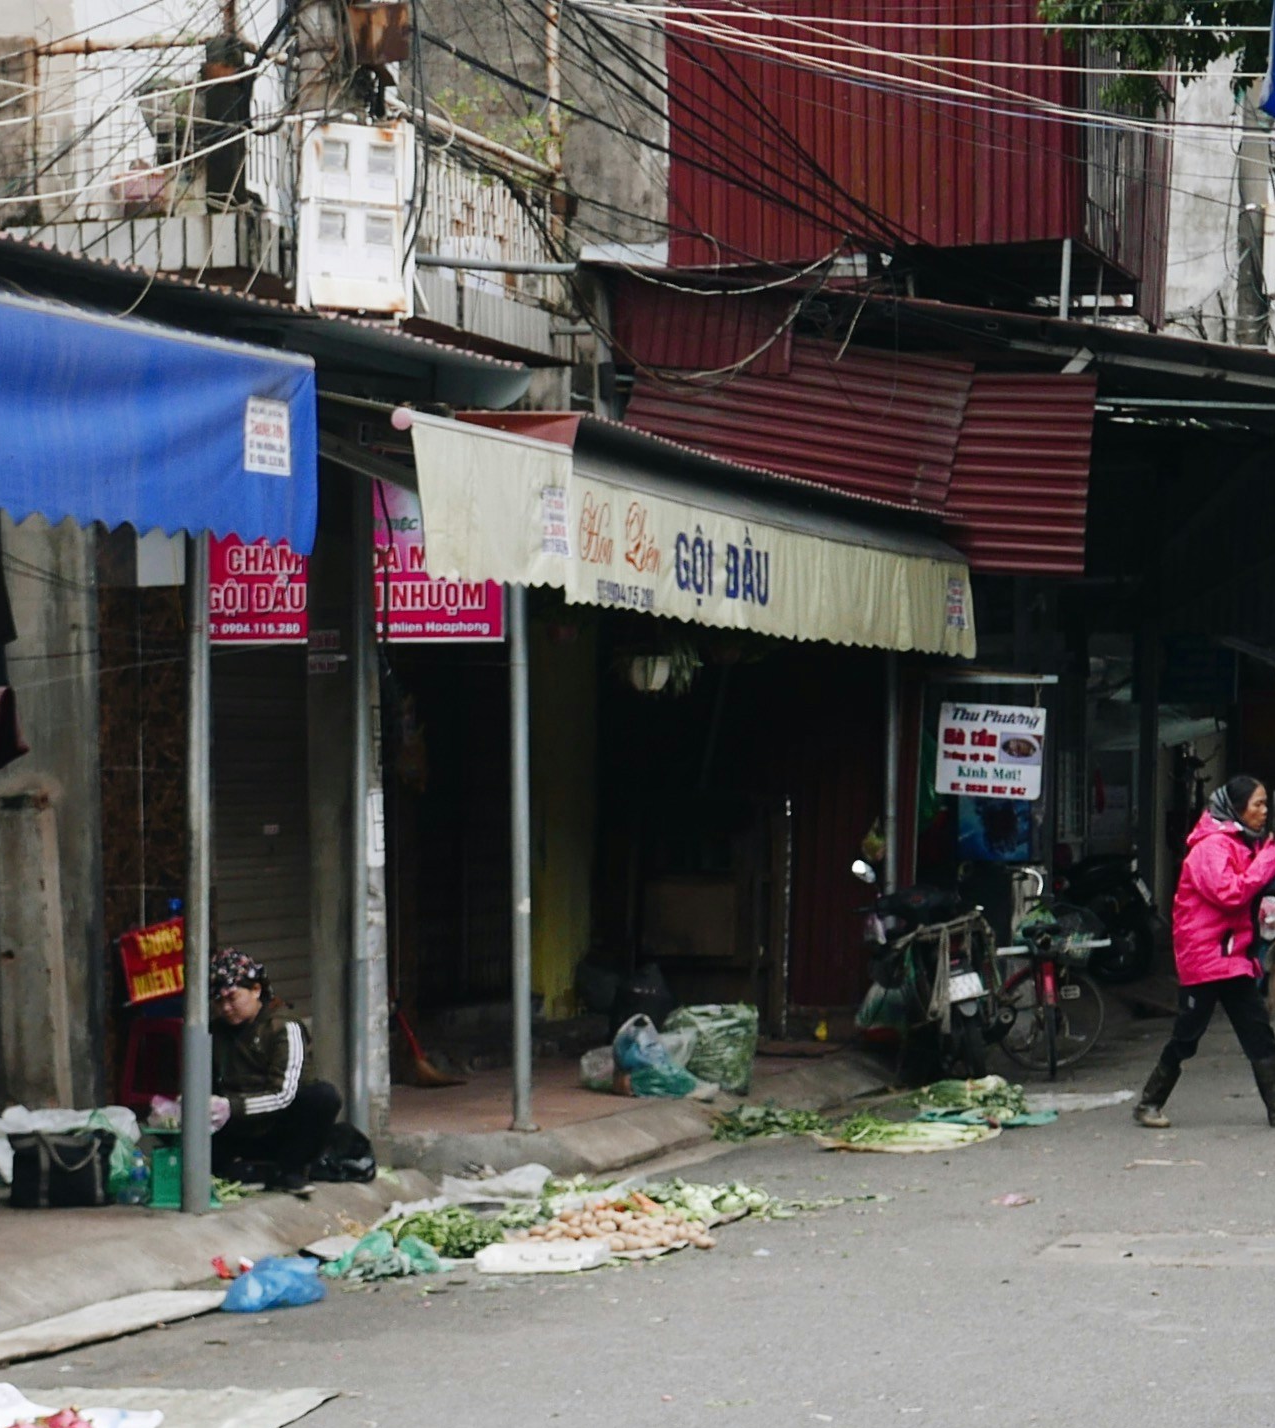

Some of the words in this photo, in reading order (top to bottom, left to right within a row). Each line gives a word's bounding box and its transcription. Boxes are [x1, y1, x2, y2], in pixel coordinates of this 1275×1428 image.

[675, 524, 713, 607] GỘI
[725, 525, 769, 607] ĐẦU
[210, 577, 249, 617] GỘI
[951, 706, 980, 722] Thu
